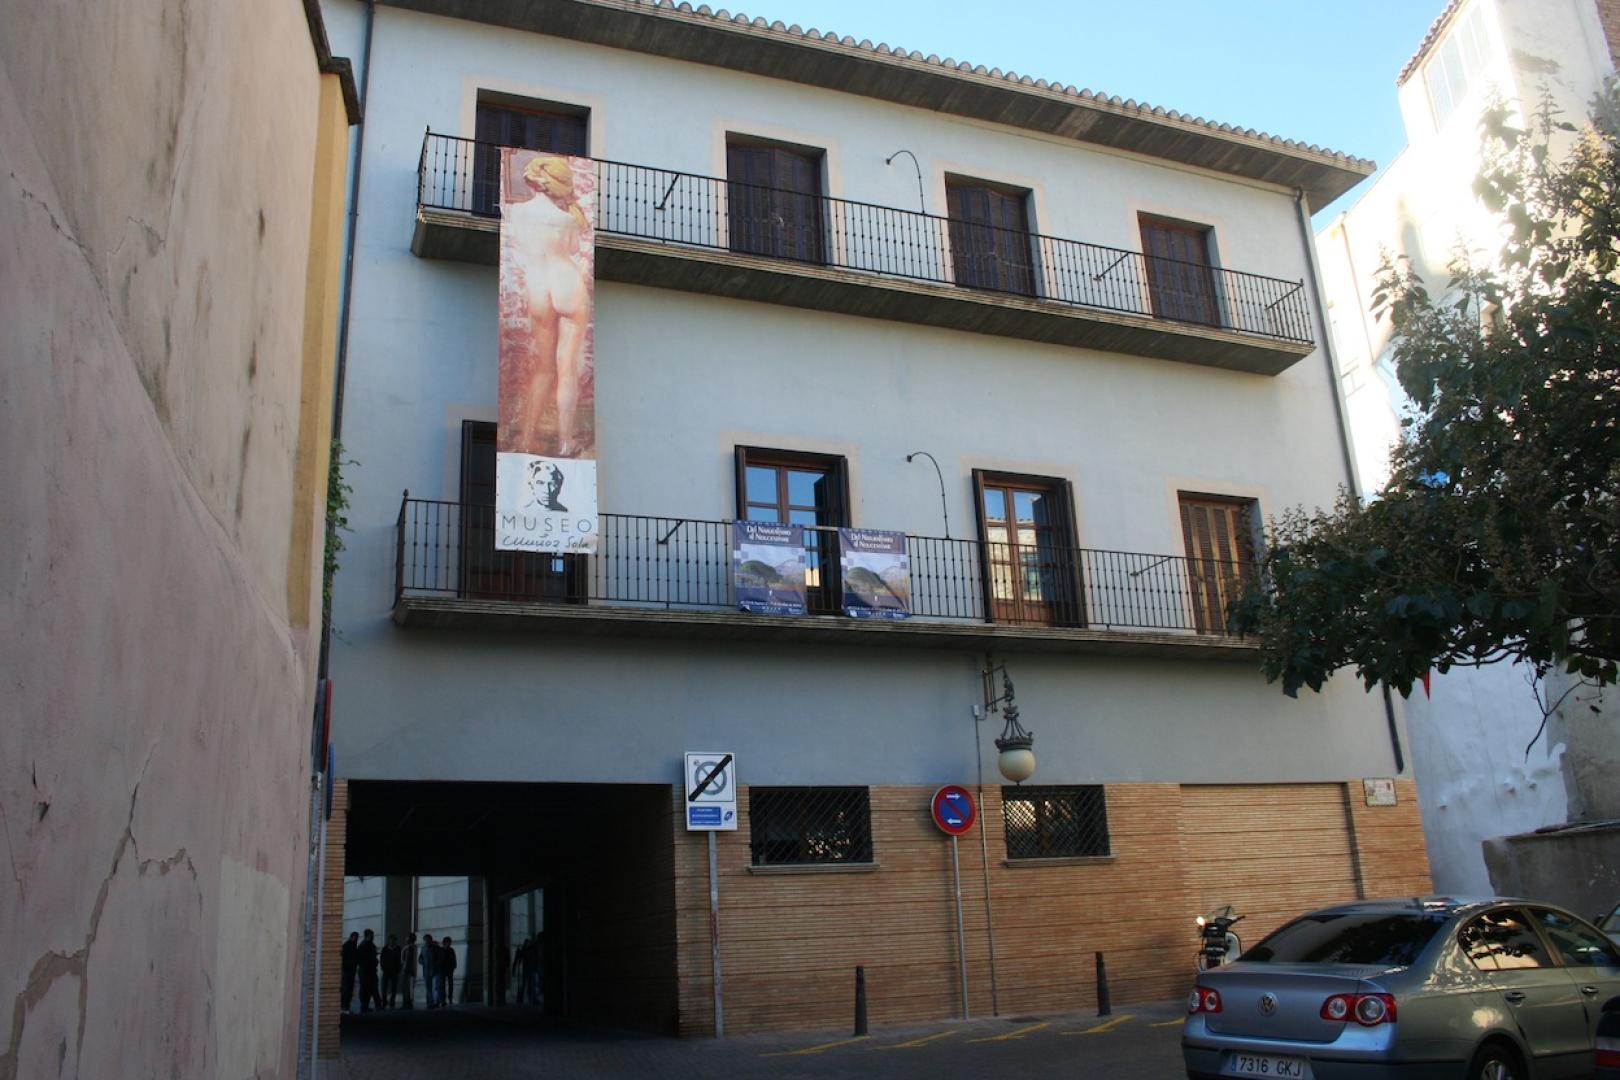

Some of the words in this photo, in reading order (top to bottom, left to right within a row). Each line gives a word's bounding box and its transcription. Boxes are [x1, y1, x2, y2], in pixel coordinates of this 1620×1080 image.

[501, 515, 592, 533] MUSEO
[1240, 1057, 1268, 1073] 7316
[1276, 1060, 1301, 1077] GKJ
